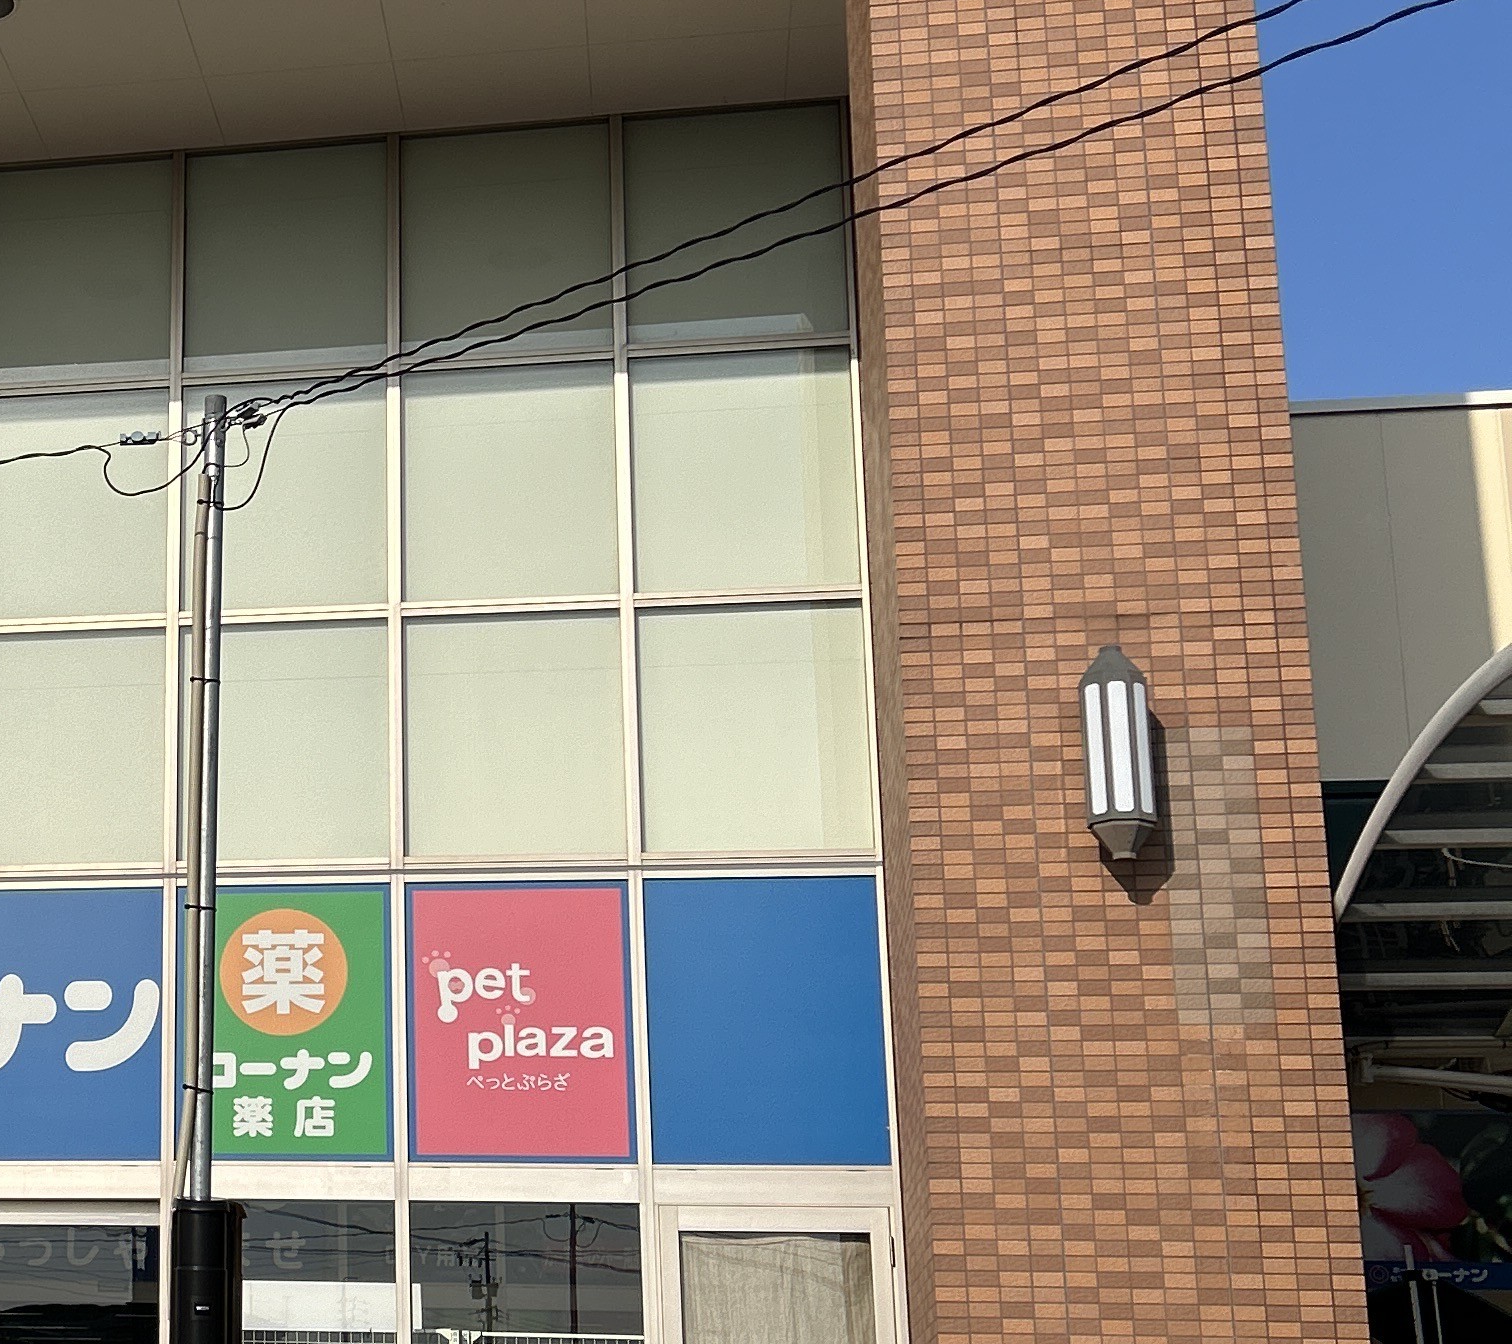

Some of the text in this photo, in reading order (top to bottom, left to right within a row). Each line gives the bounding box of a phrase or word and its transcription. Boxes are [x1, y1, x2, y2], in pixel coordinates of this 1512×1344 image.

[241, 928, 326, 1014] 薬
[437, 961, 532, 1024] pet
[210, 1047, 373, 1090] コーナン
[467, 1021, 616, 1071] plaza
[465, 1071, 571, 1093] ぺっとぷらざ
[232, 1095, 336, 1139] 薬店
